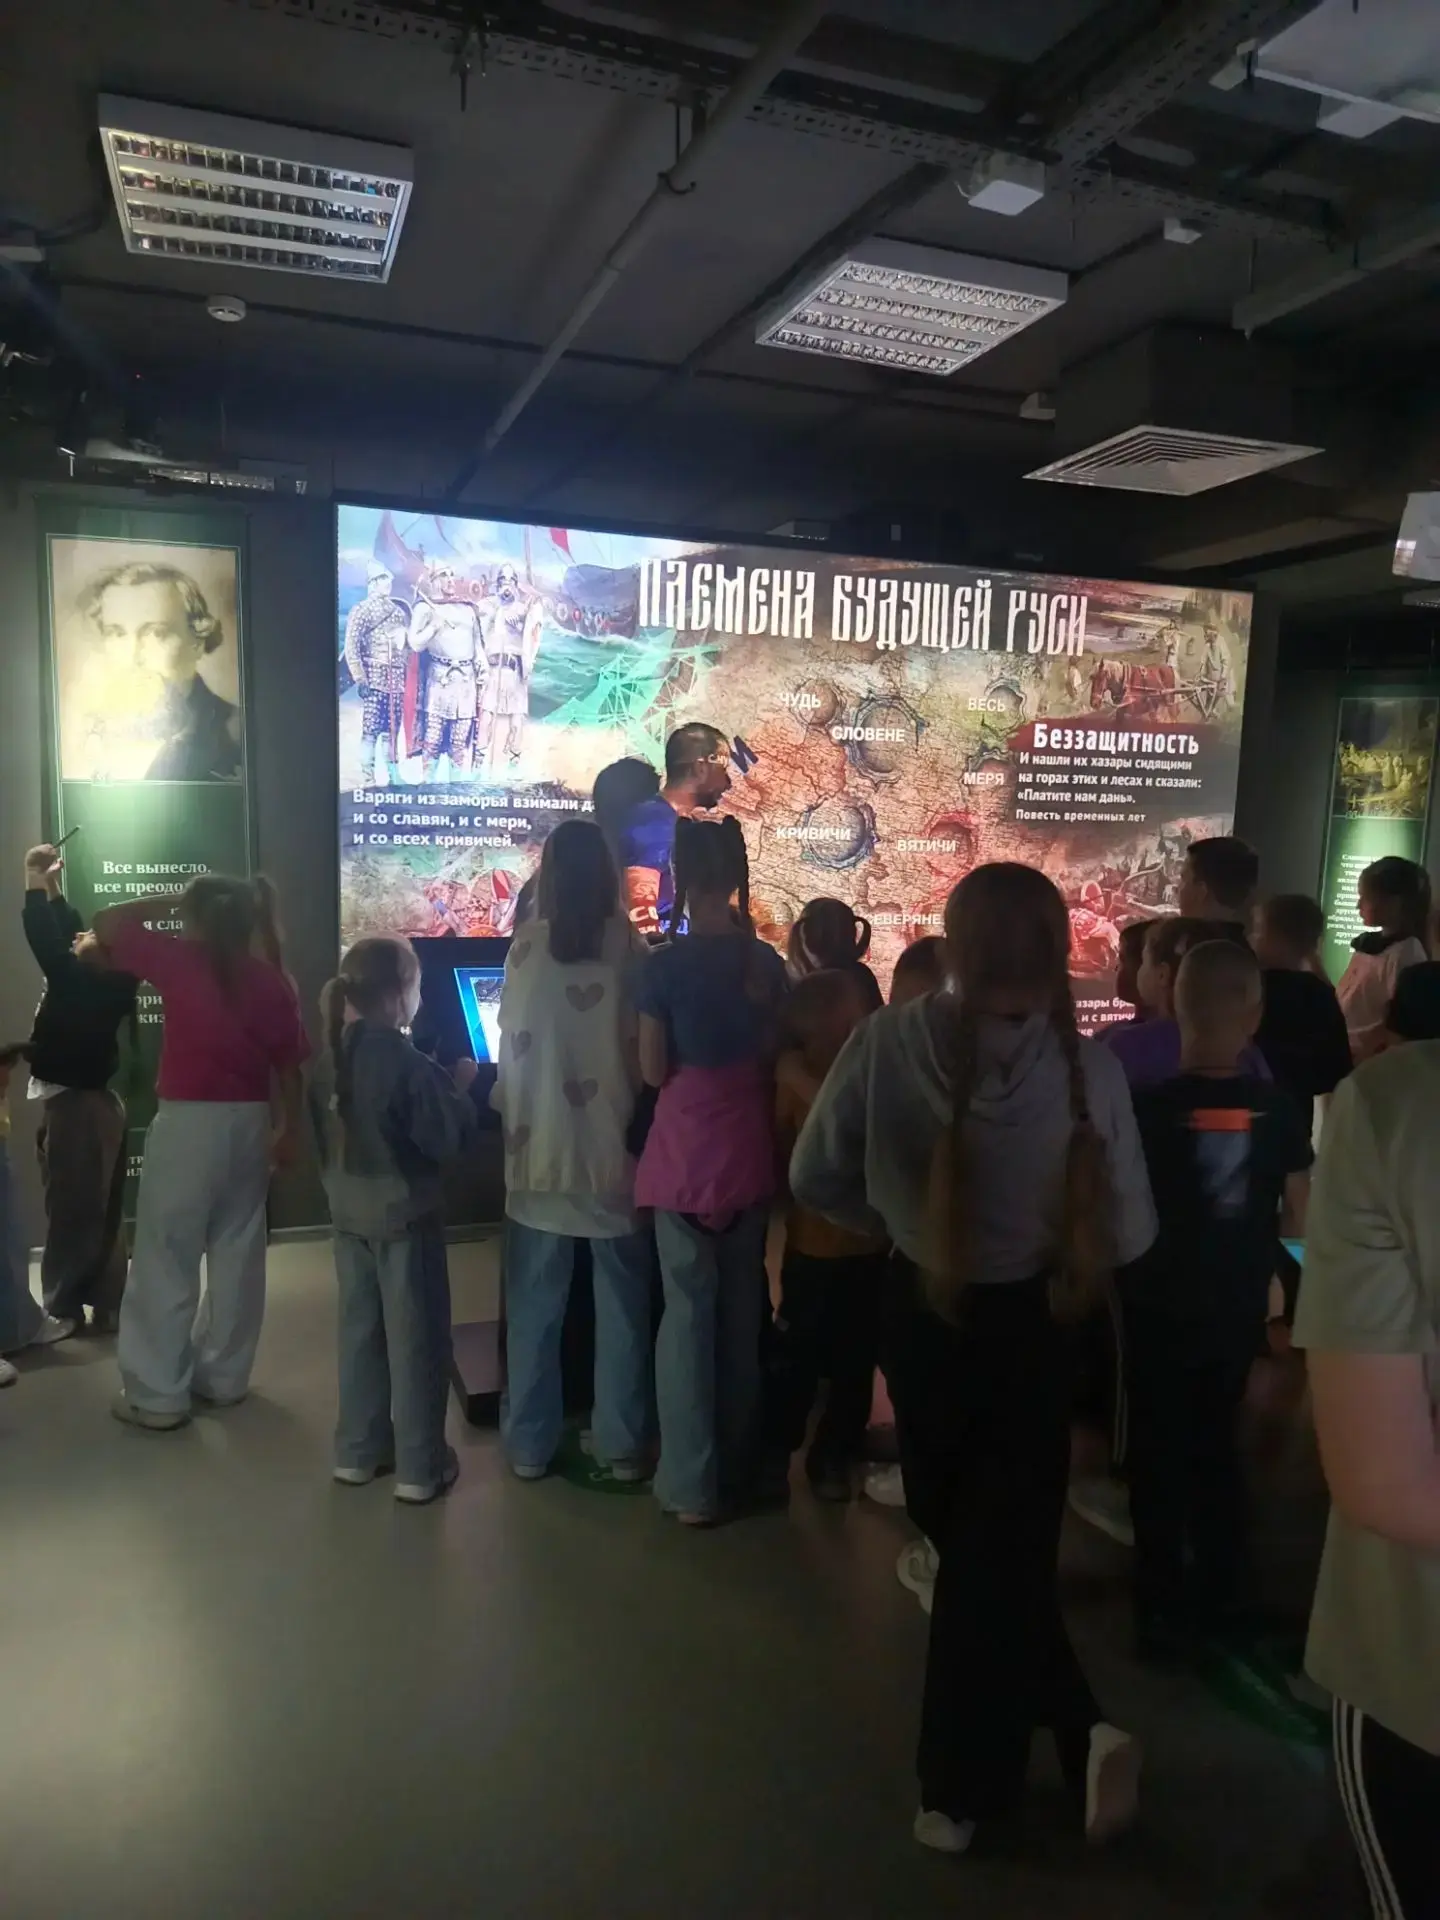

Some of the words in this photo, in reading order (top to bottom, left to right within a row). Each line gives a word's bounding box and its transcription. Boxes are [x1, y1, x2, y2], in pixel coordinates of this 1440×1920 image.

[638, 558, 815, 639] ПЛЕМЕНА
[832, 575, 993, 654] БУДУЩЕЙ
[1006, 590, 1088, 656] РУСИ
[777, 693, 821, 709] ЧУДЬ
[968, 698, 1005, 712] ВЕСЬ
[832, 726, 905, 742] СЛОВЕНЕ
[1033, 723, 1199, 755] Беззащитность
[1020, 752, 1030, 764] И
[1032, 754, 1070, 766] нашли
[1074, 756, 1088, 767] их
[1091, 757, 1132, 769] хазары
[1135, 759, 1192, 771] сидящими
[964, 772, 1004, 785] МЕРЯ
[1018, 773, 1033, 783] на
[1035, 774, 1069, 787] горах
[1072, 775, 1098, 785] этих
[1101, 775, 1108, 785] и
[1110, 776, 1142, 787] лесах
[1146, 777, 1152, 787] и
[1155, 777, 1202, 788] сказали:
[353, 789, 412, 806] Варяги
[418, 794, 436, 805] из
[440, 795, 508, 810] заморья
[513, 798, 578, 810] взимали
[1017, 789, 1071, 801] «Платите
[1074, 793, 1096, 802] нам
[353, 813, 364, 823] и
[369, 813, 387, 824] со
[393, 813, 455, 828] славян,
[459, 816, 469, 826] и
[473, 816, 482, 827] с
[487, 816, 532, 831] мери,
[1016, 809, 1061, 821] Повесть
[1064, 811, 1125, 822] временных
[1127, 813, 1146, 822] лет
[353, 834, 364, 844] и
[369, 833, 387, 844] со
[393, 834, 430, 845] всех
[435, 834, 517, 848] кривичей.
[777, 828, 851, 840] КРИВИЧИ
[897, 839, 956, 852] ВЯТИЧИ
[102, 861, 132, 874] Все
[94, 883, 121, 893] все
[125, 883, 184, 896] преодо
[157, 920, 183, 930] сла
